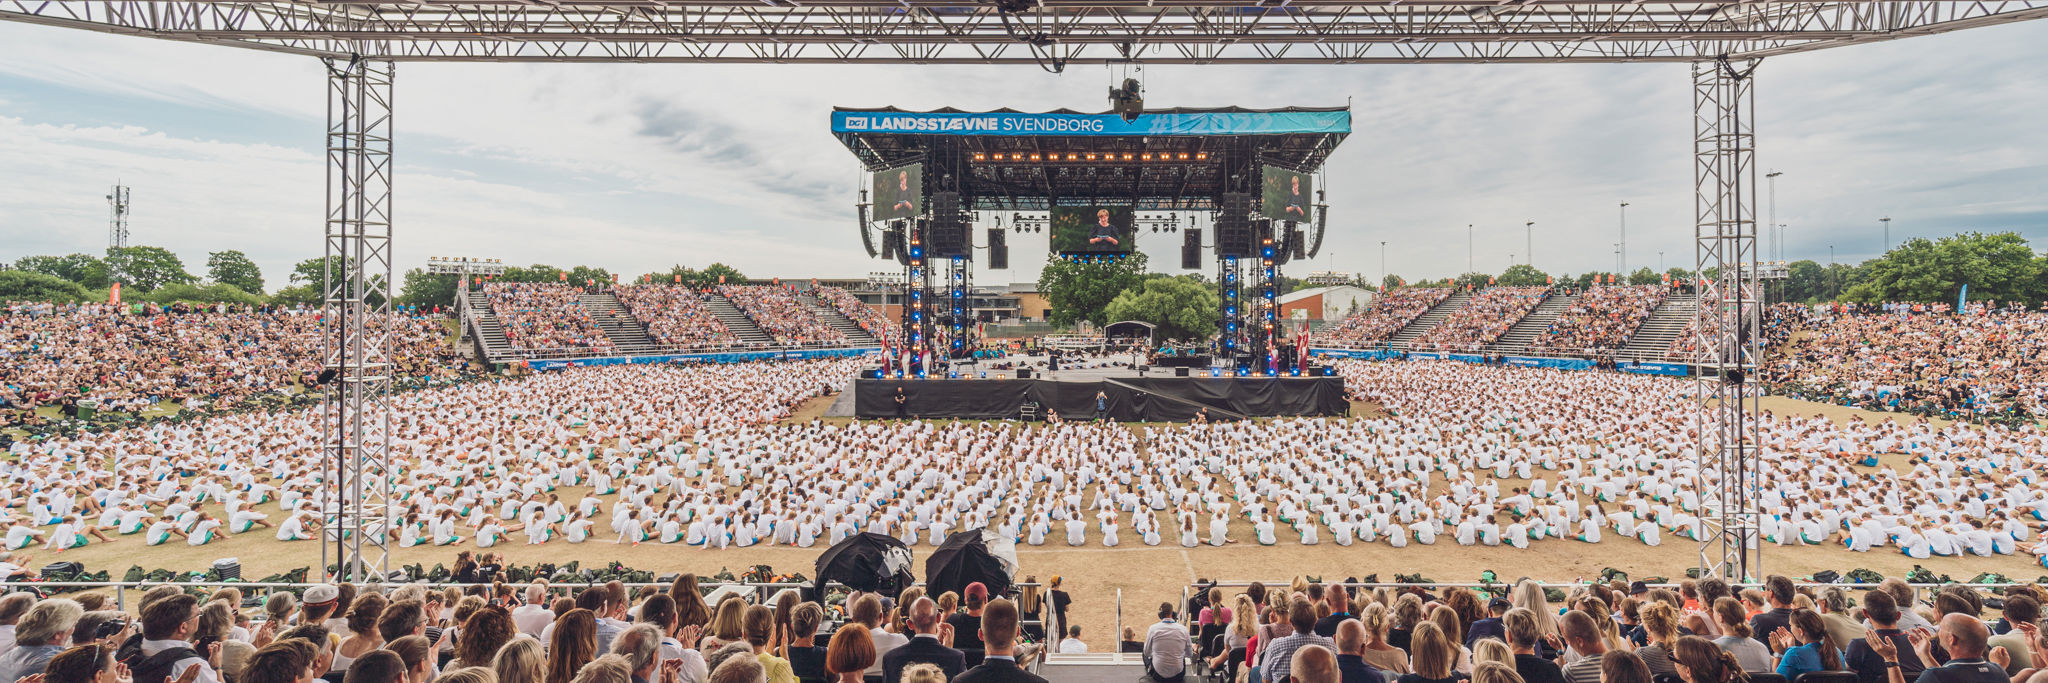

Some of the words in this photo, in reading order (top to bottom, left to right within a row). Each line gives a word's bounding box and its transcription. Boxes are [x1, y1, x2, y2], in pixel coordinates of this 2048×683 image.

[848, 119, 865, 127] DGI
[871, 117, 998, 131] LANDSSTÆVNE
[1003, 118, 1104, 132] SVENDBORG
[1149, 113, 1273, 132] #L2022
